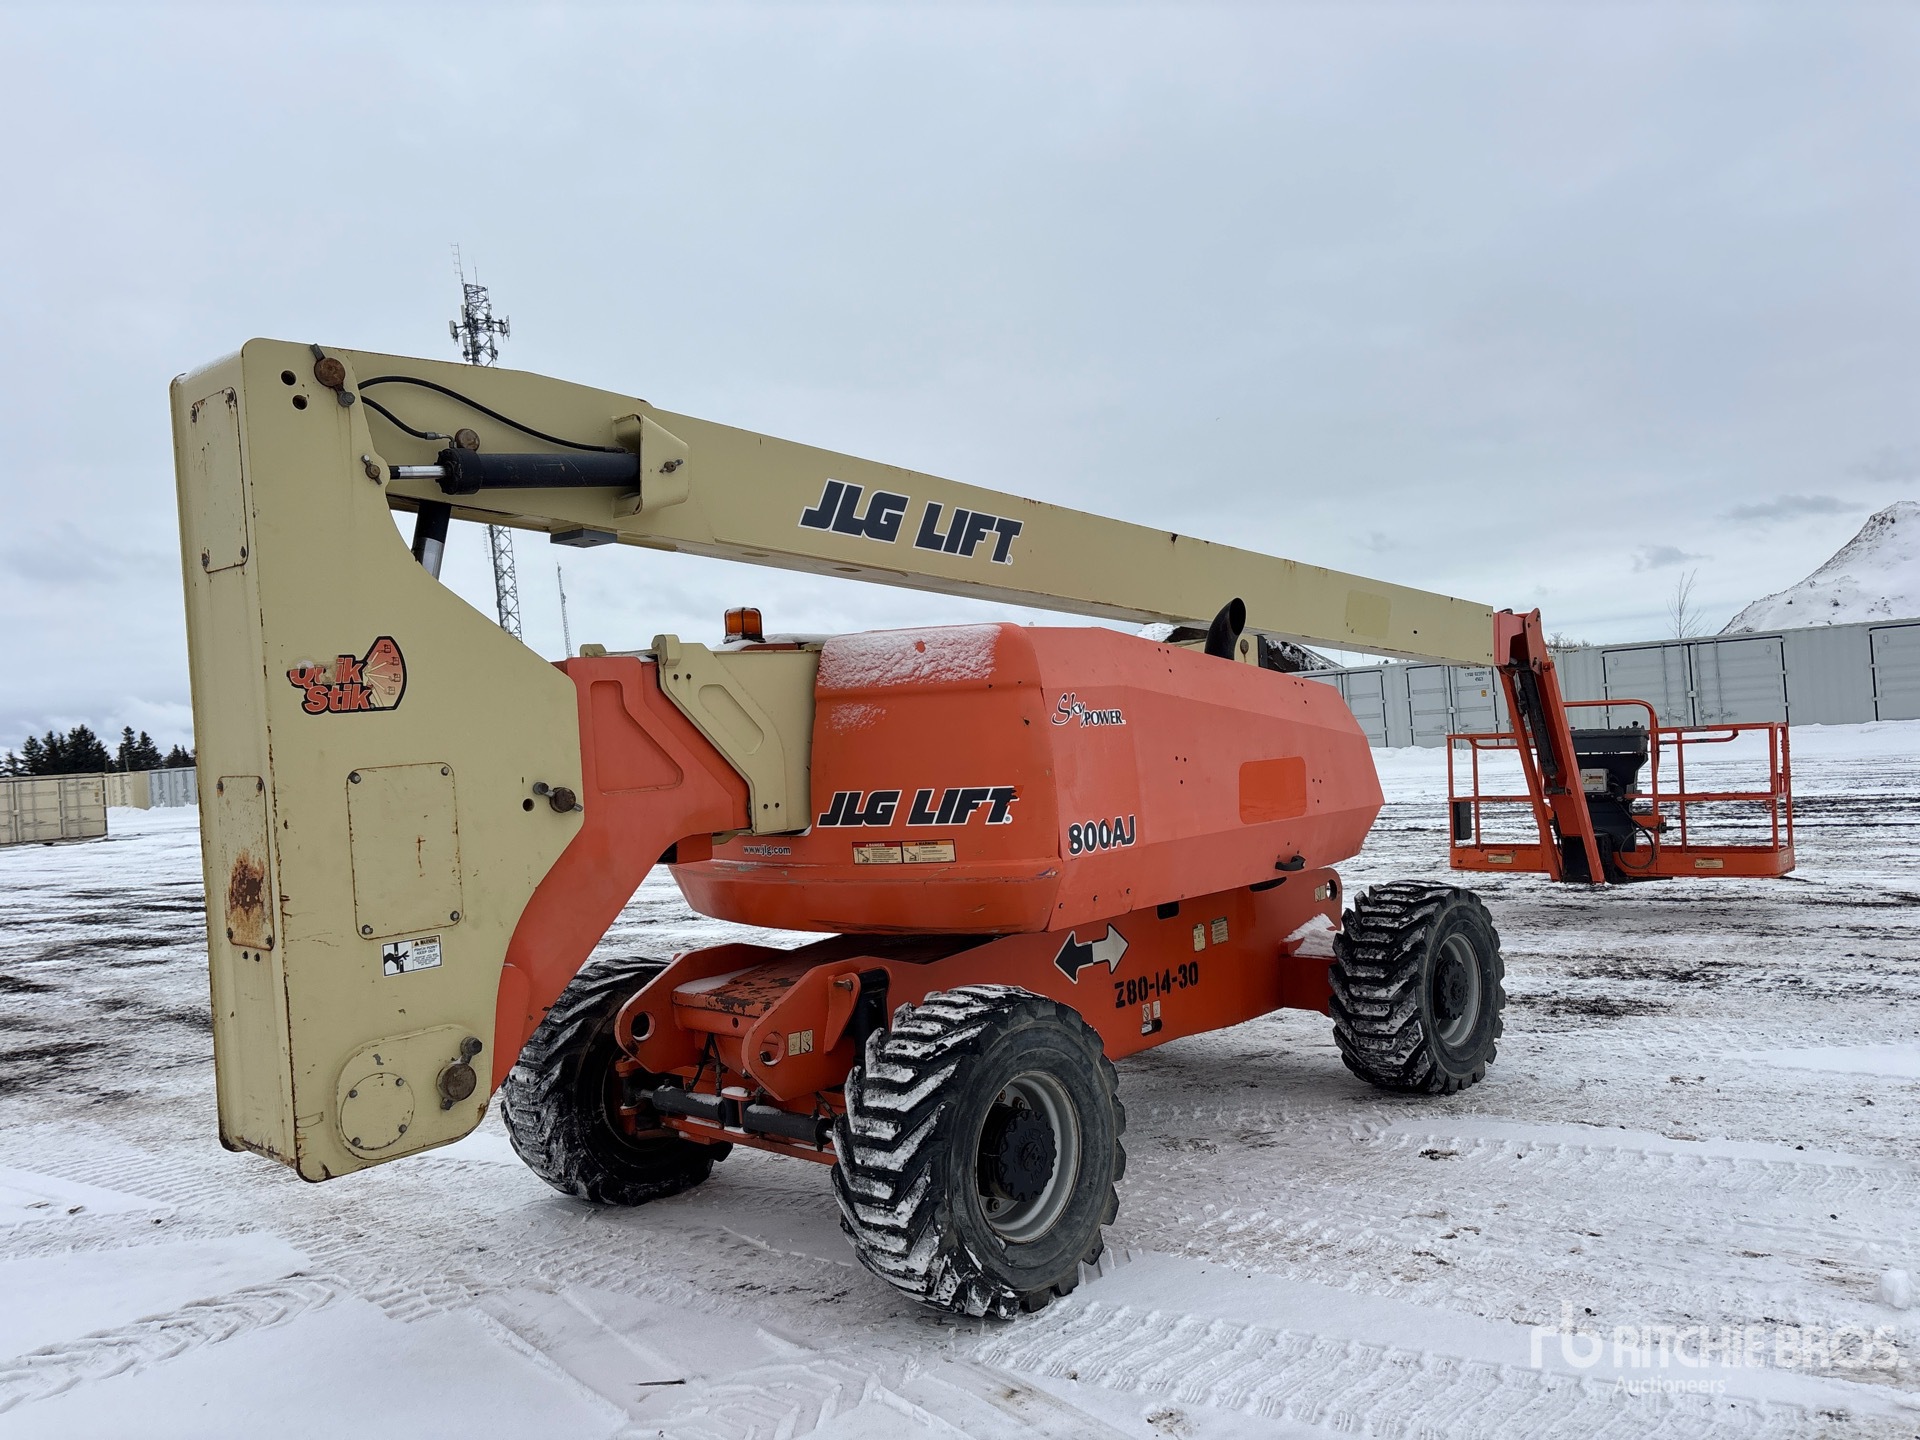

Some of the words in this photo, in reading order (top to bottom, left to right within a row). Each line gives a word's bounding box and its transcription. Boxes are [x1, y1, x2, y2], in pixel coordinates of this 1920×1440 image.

[799, 479, 910, 543] JLG
[913, 502, 1024, 564] LIFT
[303, 683, 371, 713] Stik
[817, 789, 902, 827] JLG
[906, 786, 1018, 826] LIFT
[743, 844, 791, 857] www.jlg.com
[1068, 814, 1136, 856] 800AJ
[1114, 961, 1199, 1009] Z80-14-30
